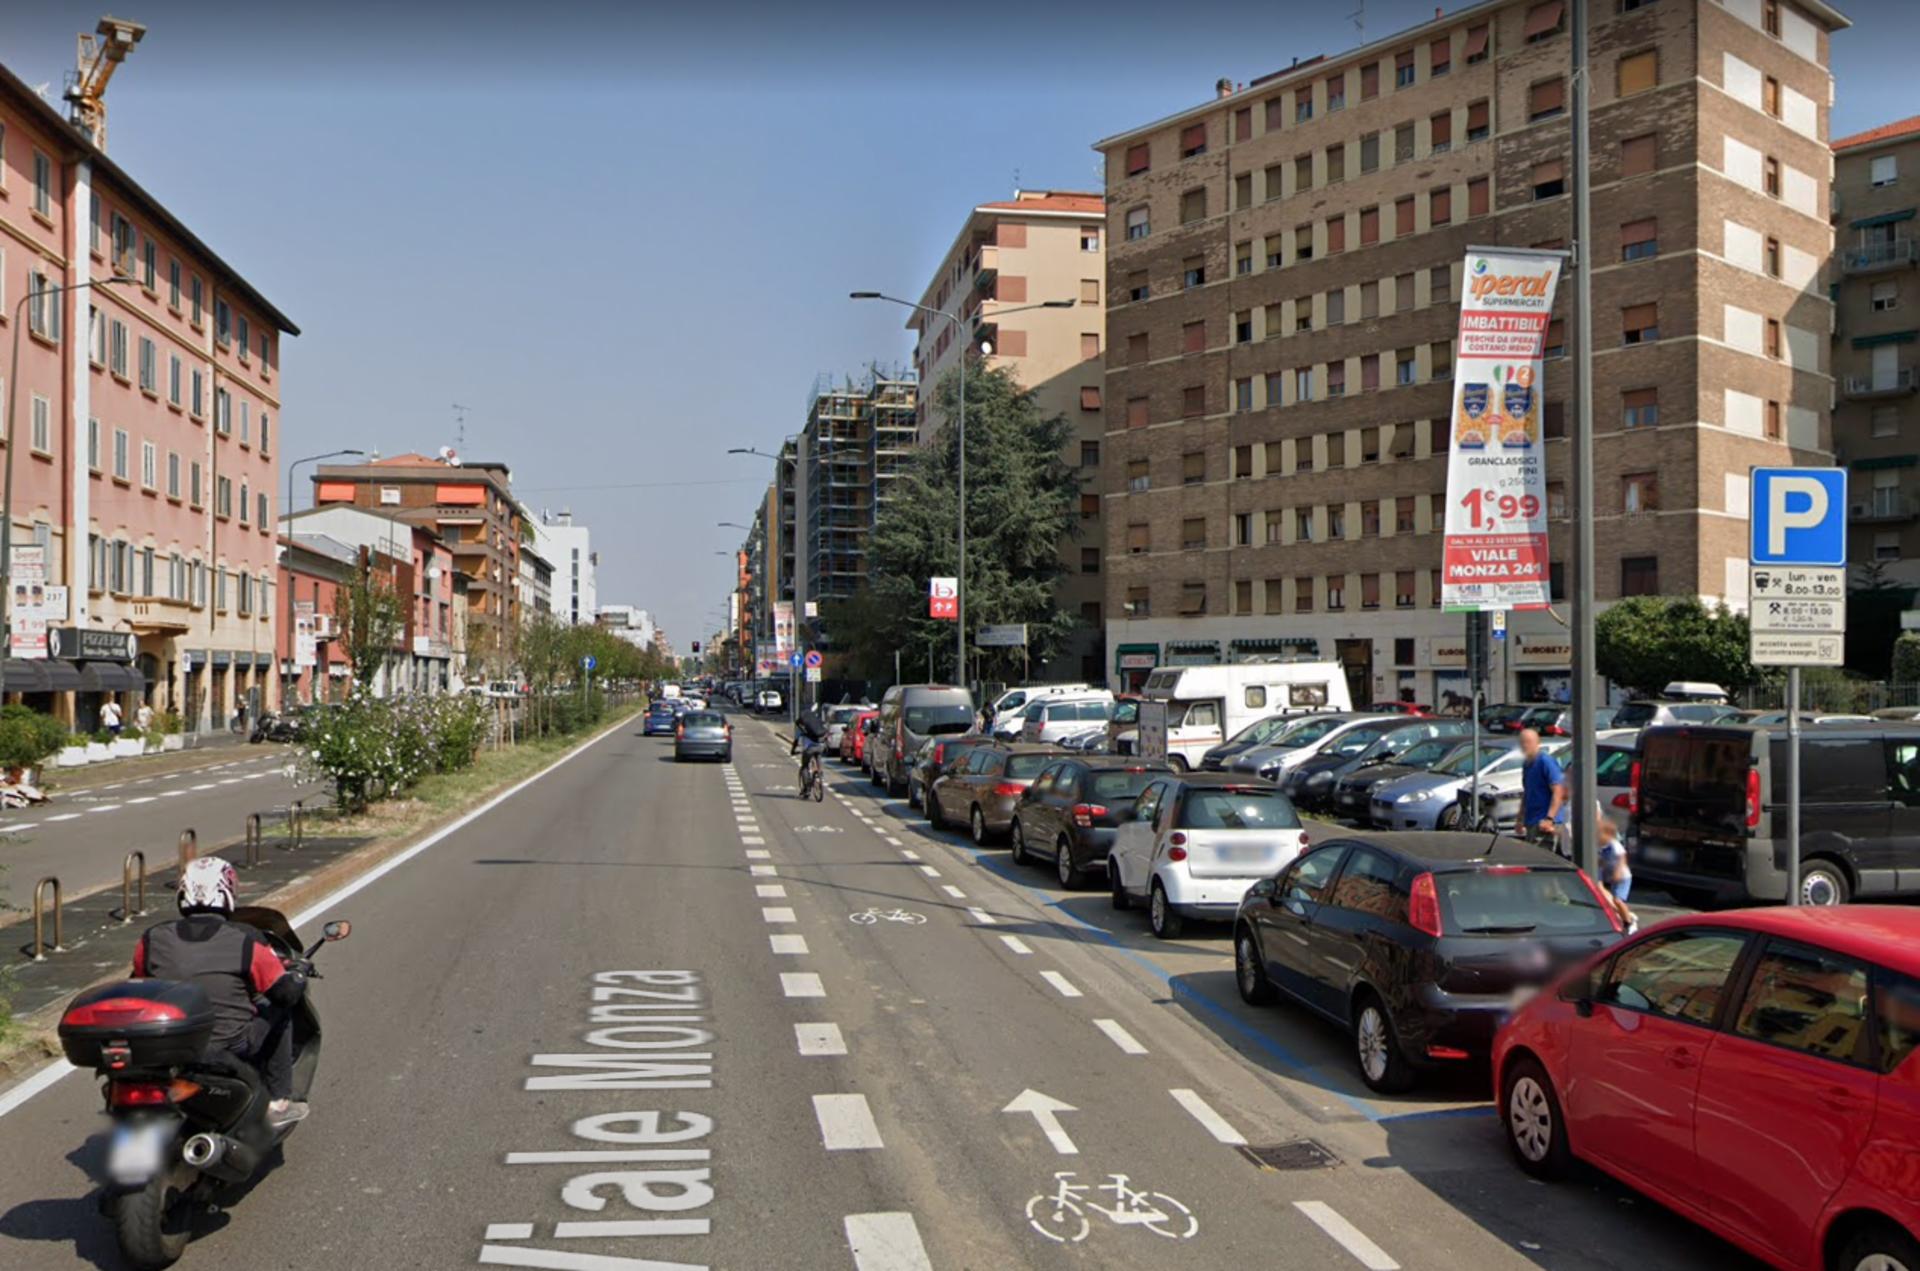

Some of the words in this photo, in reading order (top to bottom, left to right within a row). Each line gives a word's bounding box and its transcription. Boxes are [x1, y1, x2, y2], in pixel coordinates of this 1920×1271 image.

[1471, 270, 1552, 301] iperal
[1483, 296, 1545, 307] SUPERMERCATI
[1463, 316, 1546, 331] IMBATTIBILI
[1468, 343, 1507, 352] COSTANO
[1509, 344, 1533, 352] MENO
[1468, 456, 1538, 466] GRANCLASSICI
[1518, 466, 1538, 475] FINI
[1768, 476, 1829, 556] P
[1471, 549, 1518, 561] VIALE
[1450, 564, 1510, 577] MONZA
[1513, 562, 1544, 576] 241
[1788, 571, 1807, 582] lun
[1816, 574, 1837, 582] ven
[83, 631, 125, 647] PIZZERIA
[1438, 648, 1466, 656] EUROB
[1523, 645, 1562, 654] EUROBET
